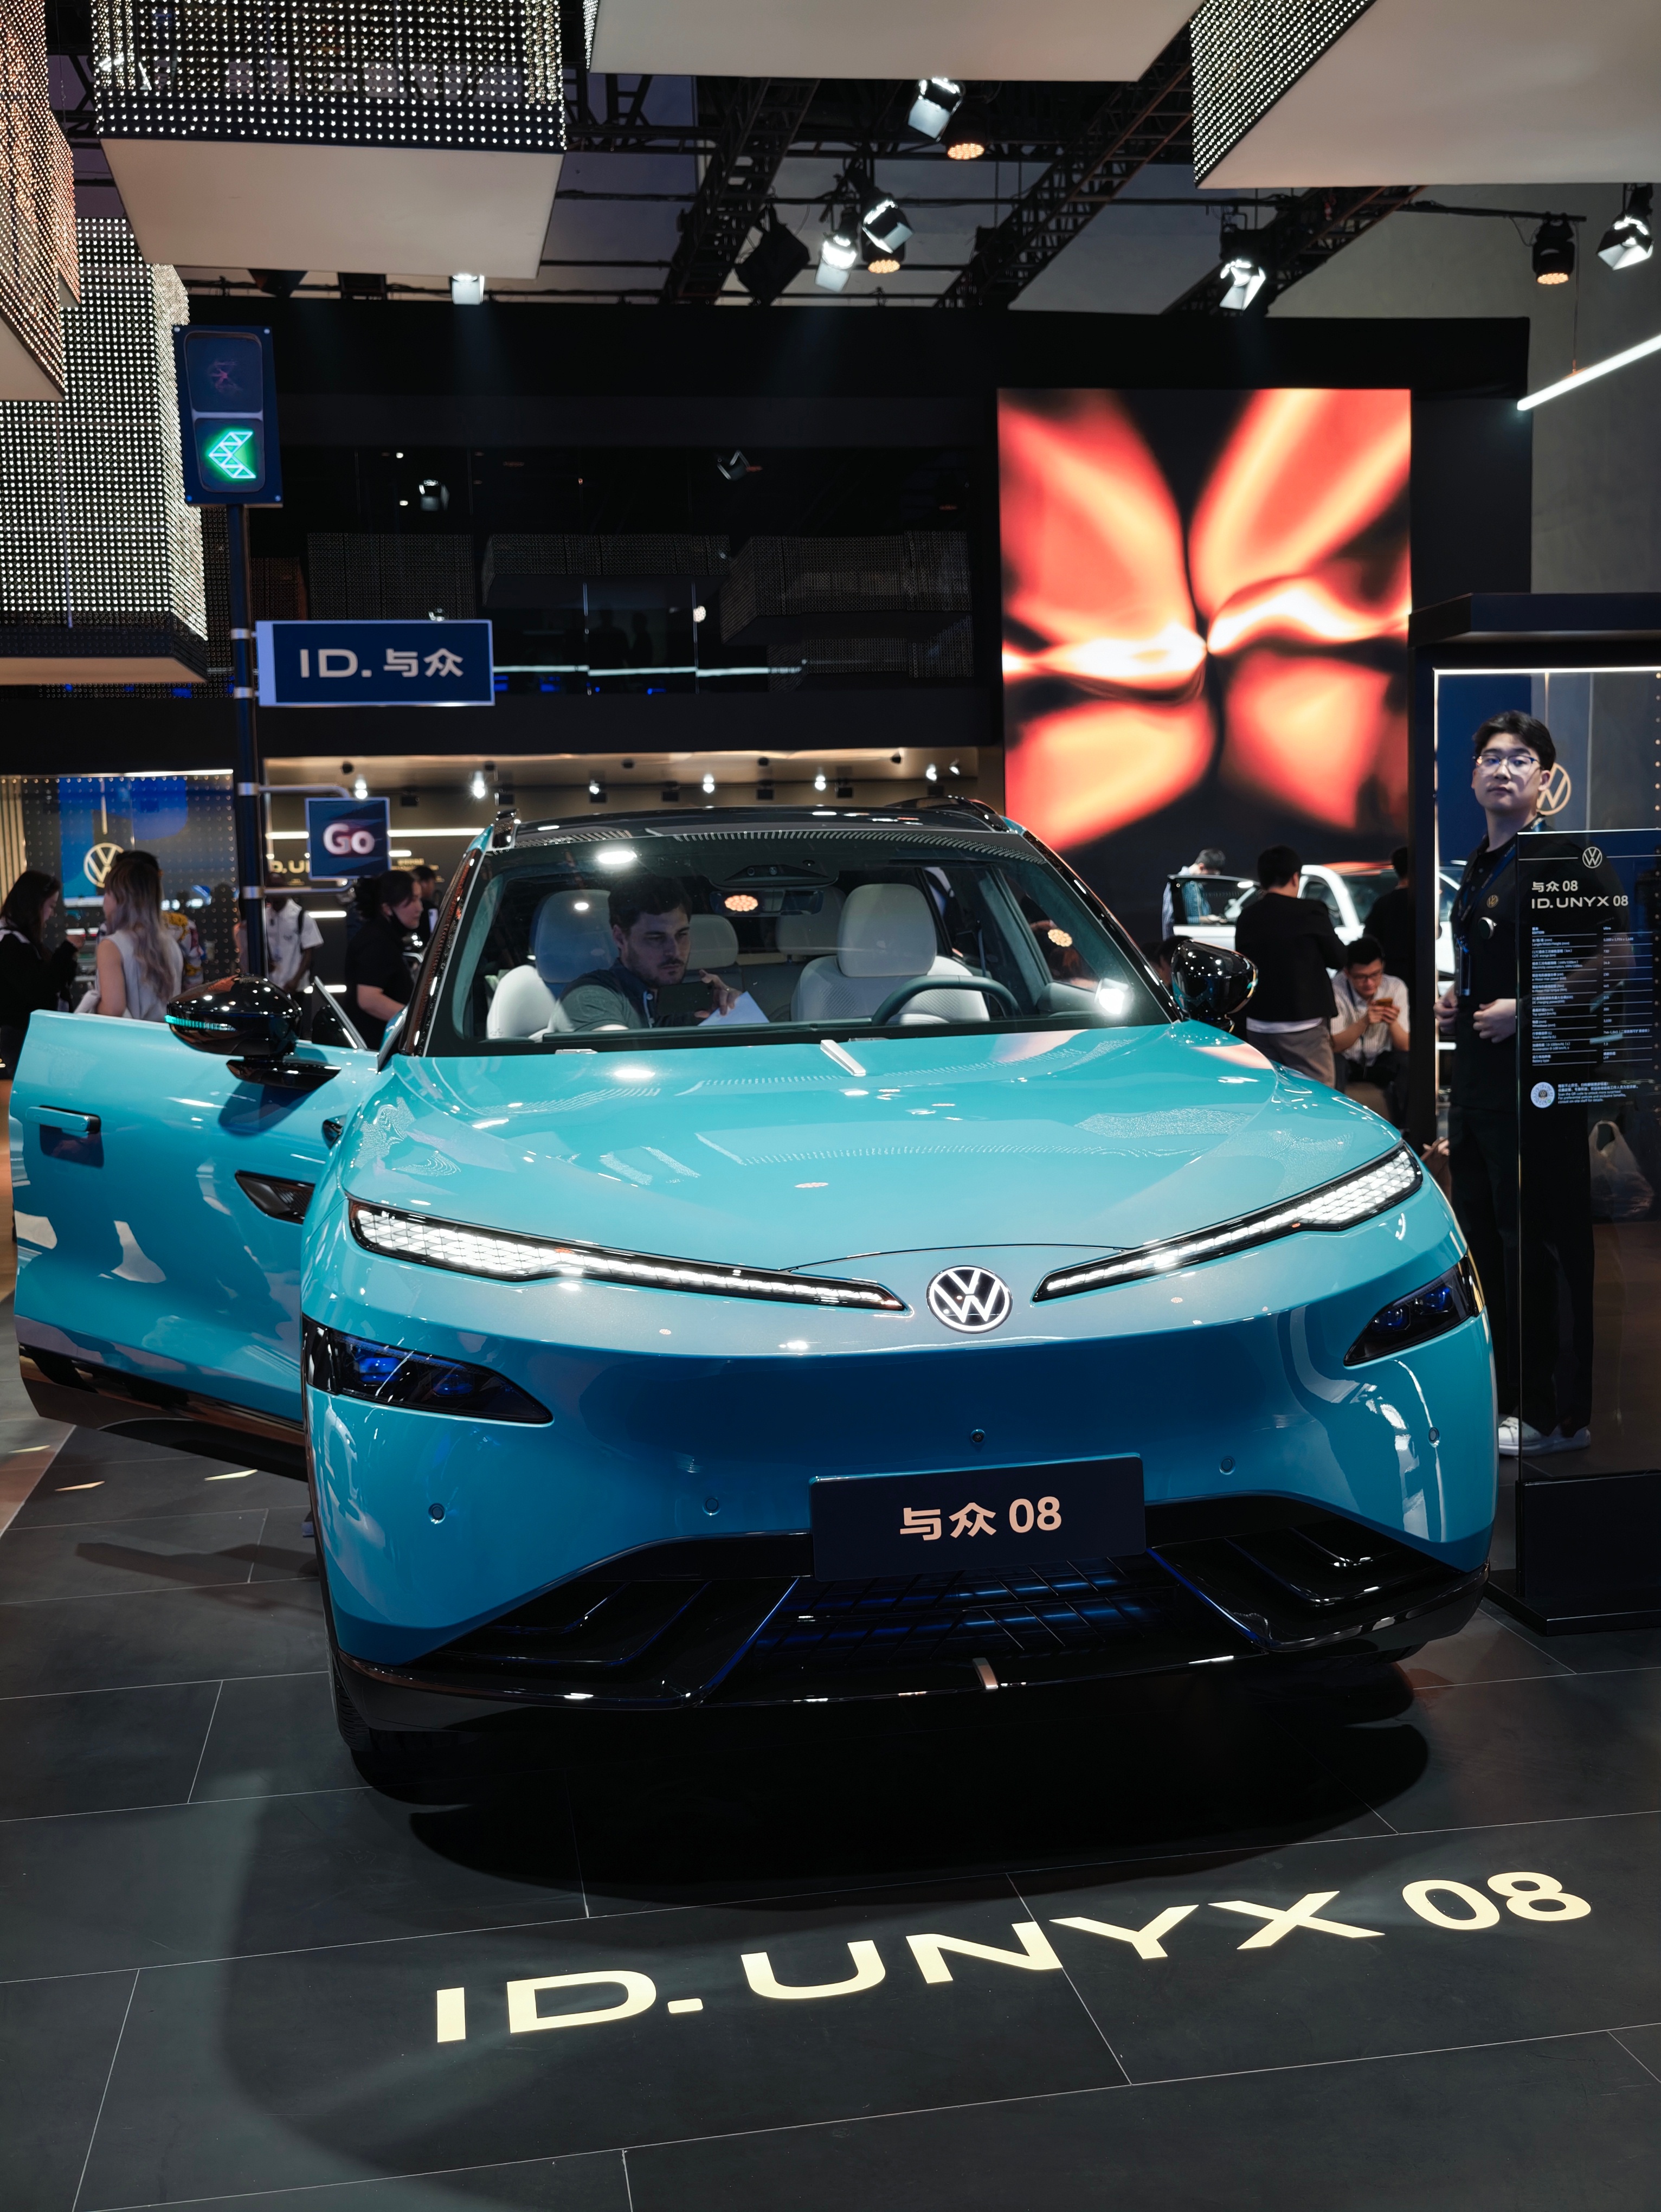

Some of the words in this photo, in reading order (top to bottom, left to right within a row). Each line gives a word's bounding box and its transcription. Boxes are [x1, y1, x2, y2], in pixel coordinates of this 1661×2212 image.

[300, 649, 371, 677] ID.
[384, 648, 462, 677] 与众
[323, 823, 375, 855] Go
[1532, 881, 1559, 892] 与众
[1563, 880, 1578, 891] 08
[1613, 896, 1628, 906] 08
[900, 1503, 996, 1540] 与众
[1009, 1496, 1061, 1533] 08
[1402, 1872, 1591, 1930] 08
